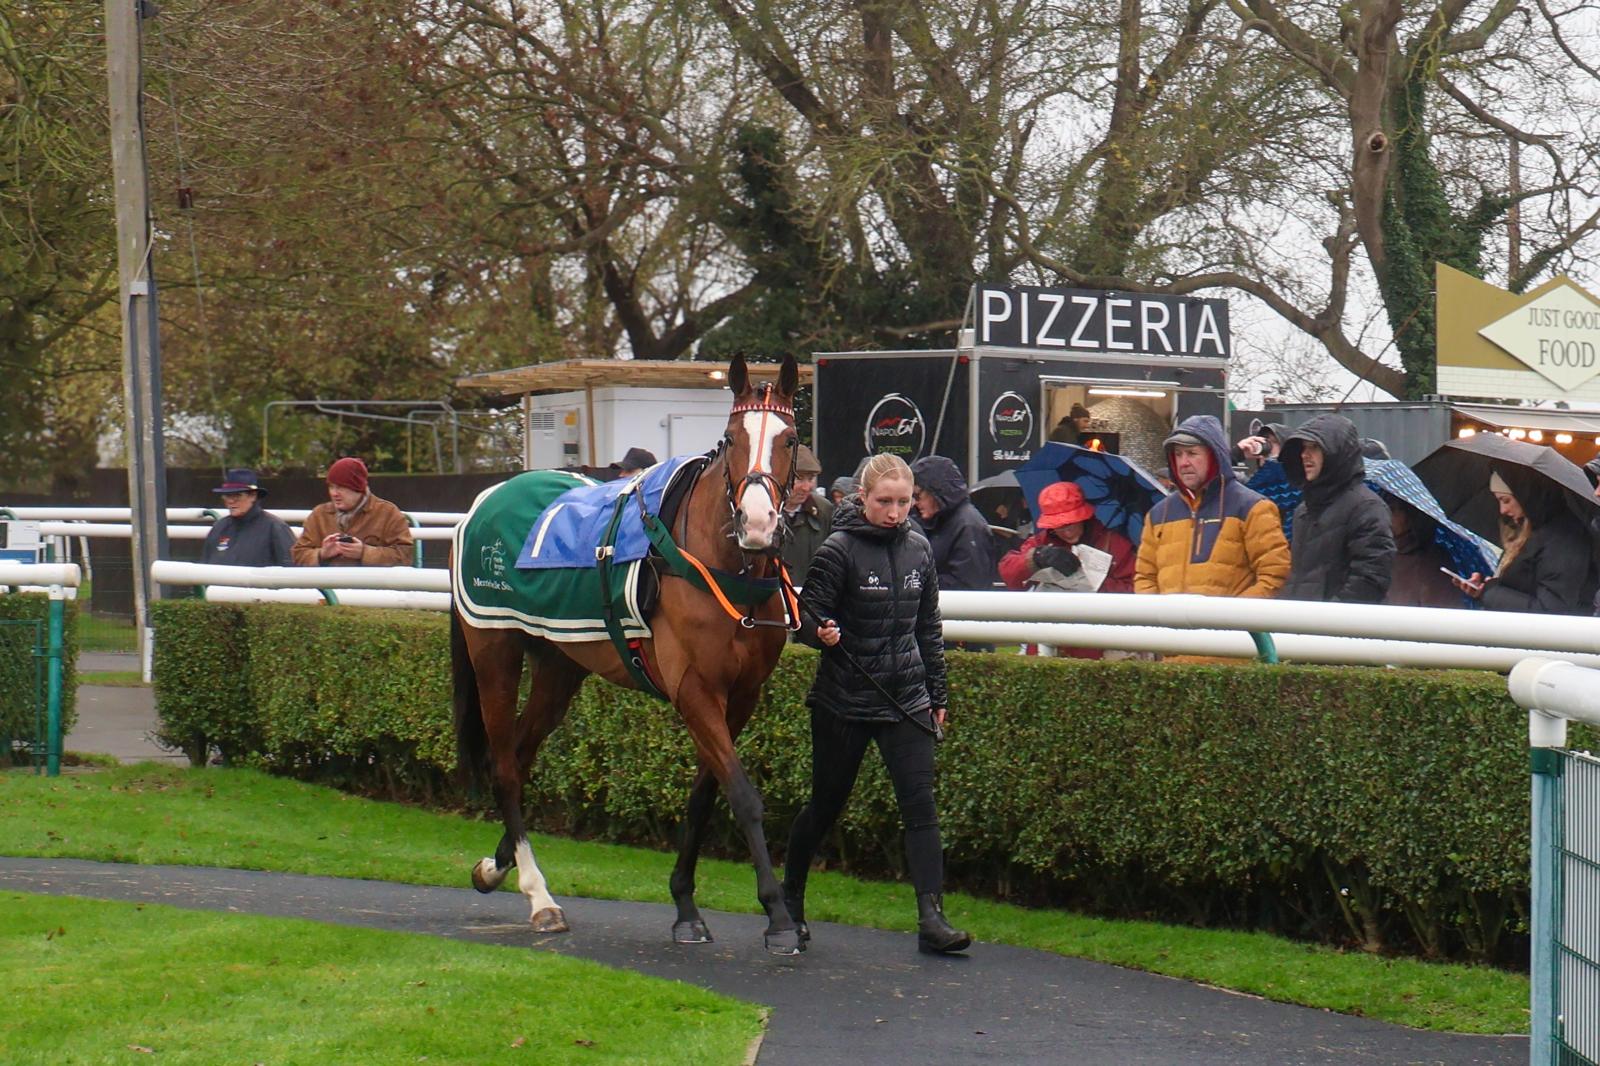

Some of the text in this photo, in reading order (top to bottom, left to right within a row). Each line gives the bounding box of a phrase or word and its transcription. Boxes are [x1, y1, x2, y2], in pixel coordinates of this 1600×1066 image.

[982, 289, 1225, 355] PIZZERIA
[1528, 307, 1600, 330] JUST GOOD
[1539, 339, 1595, 368] FOOD
